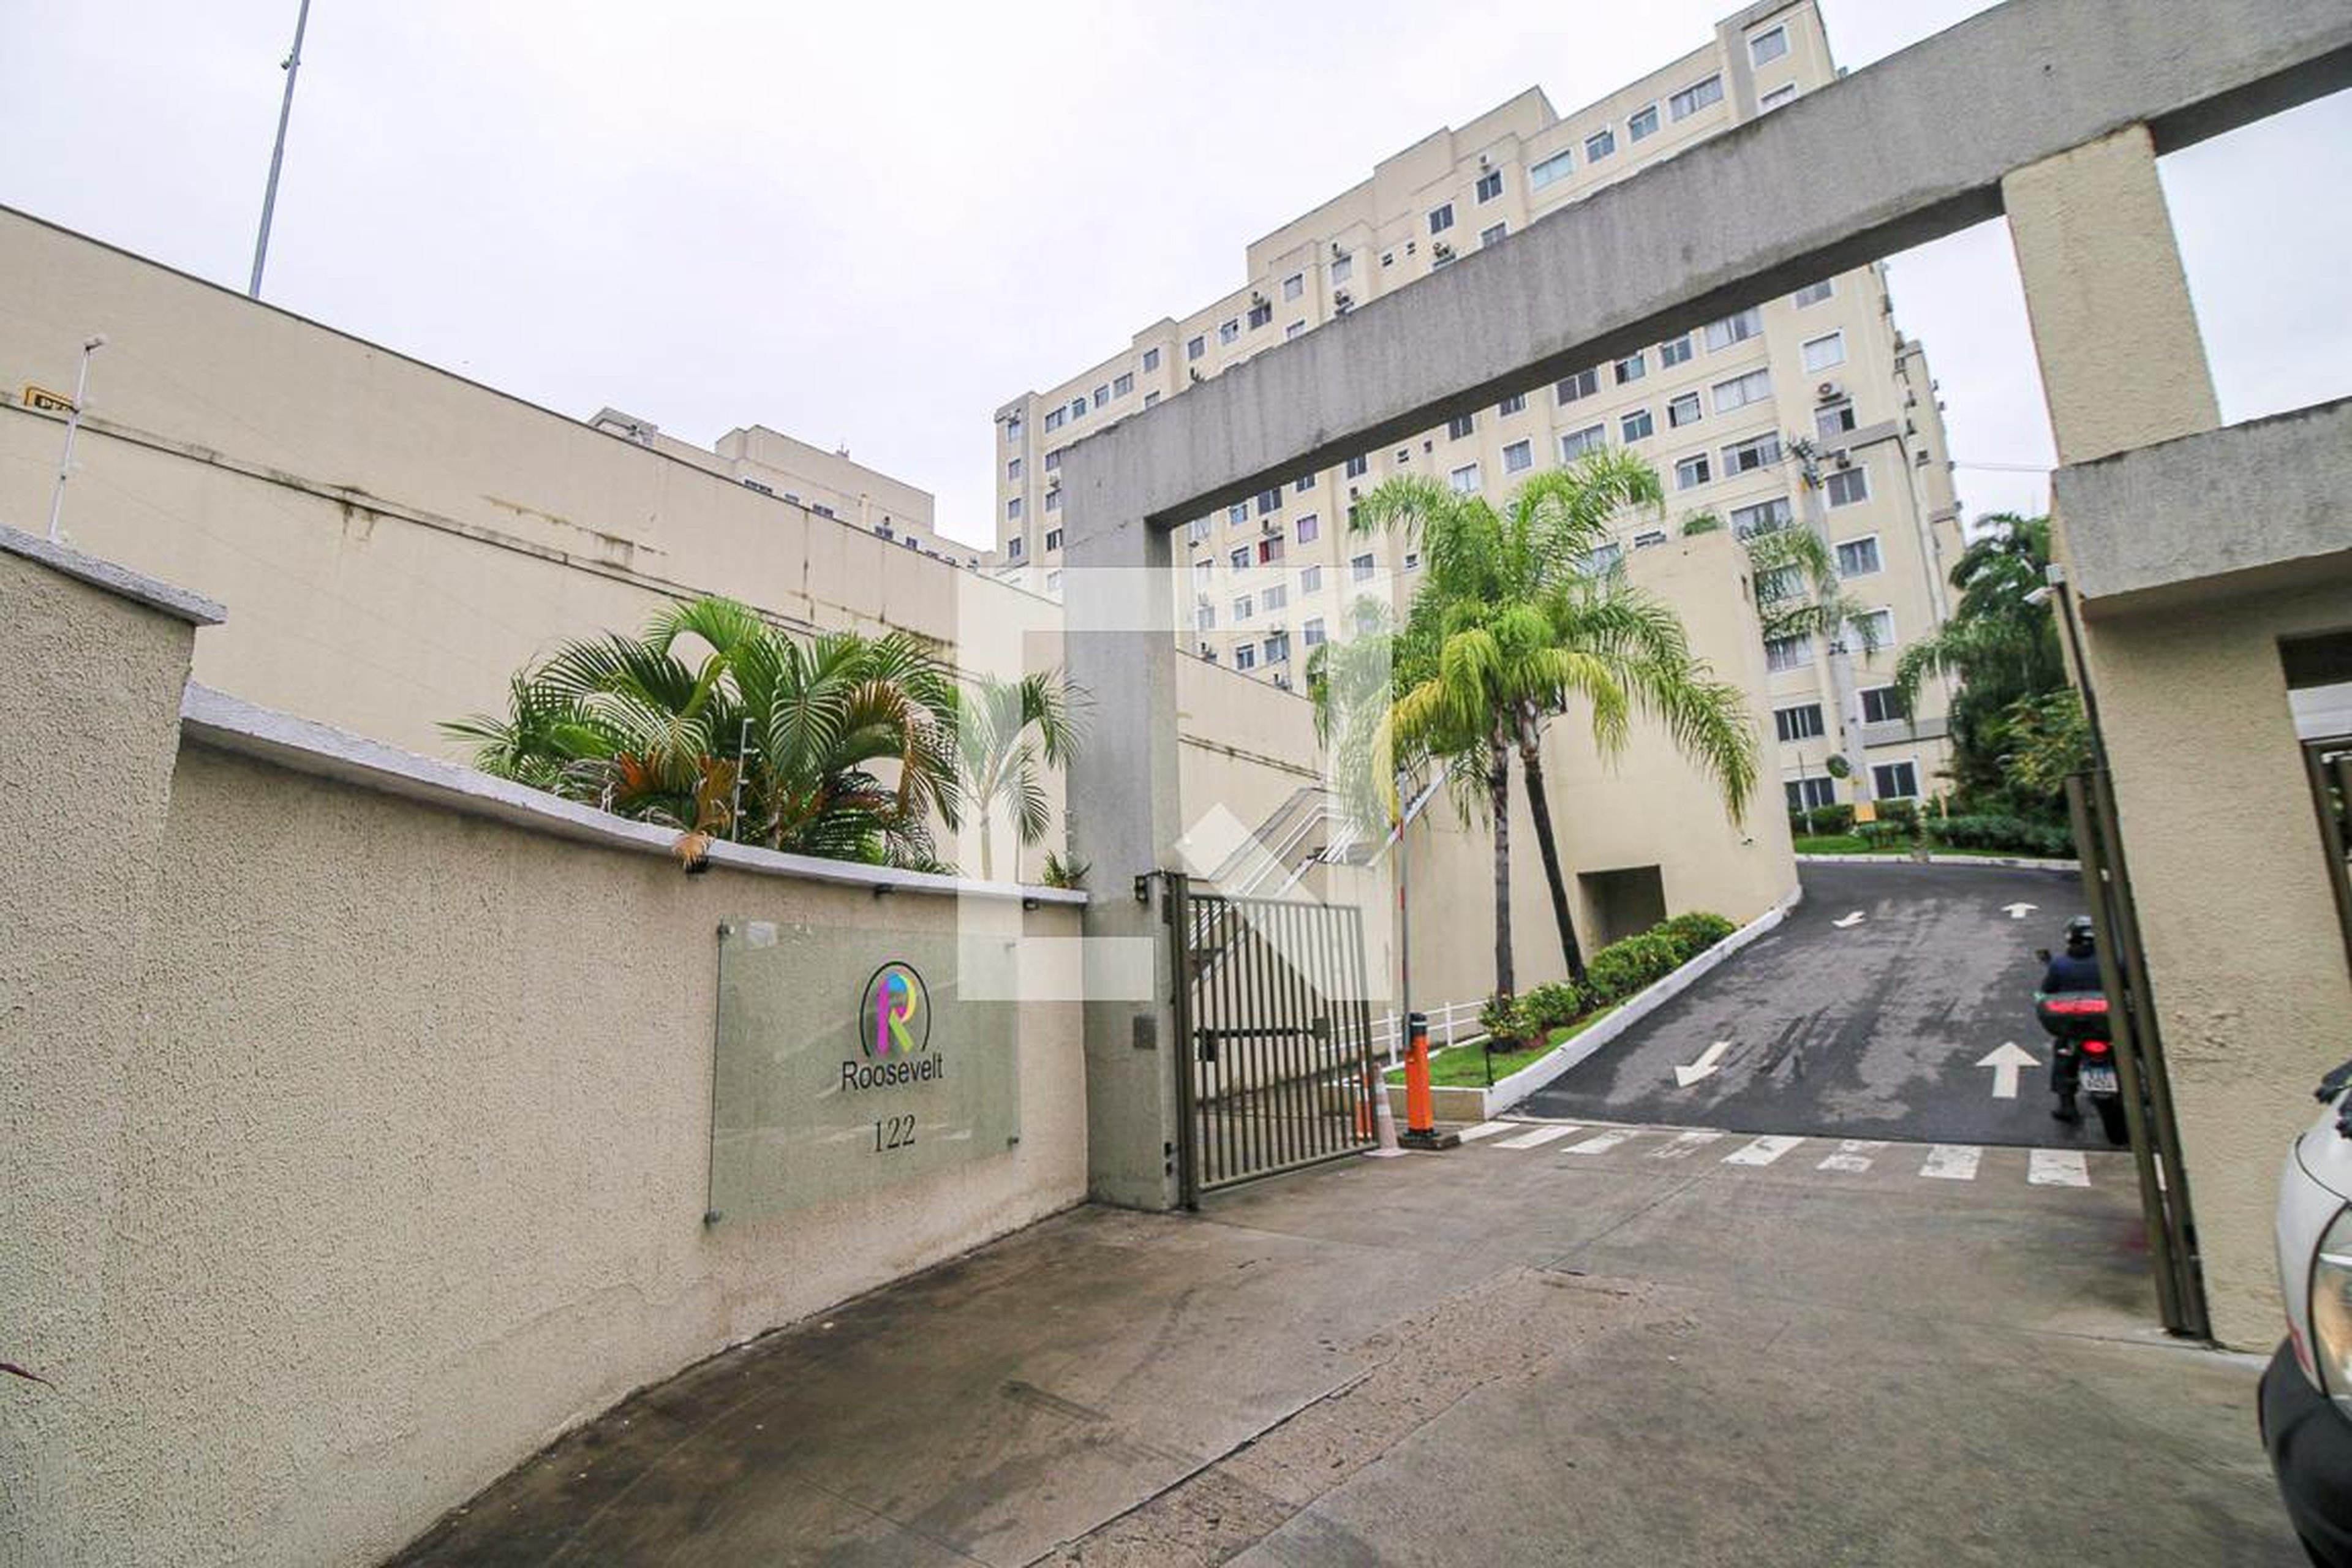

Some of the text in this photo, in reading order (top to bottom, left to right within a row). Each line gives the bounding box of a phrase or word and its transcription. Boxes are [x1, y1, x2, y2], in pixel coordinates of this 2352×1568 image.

[876, 973, 916, 1056] R
[842, 1052, 943, 1092] Roosevelt
[874, 1114, 916, 1153] 122
